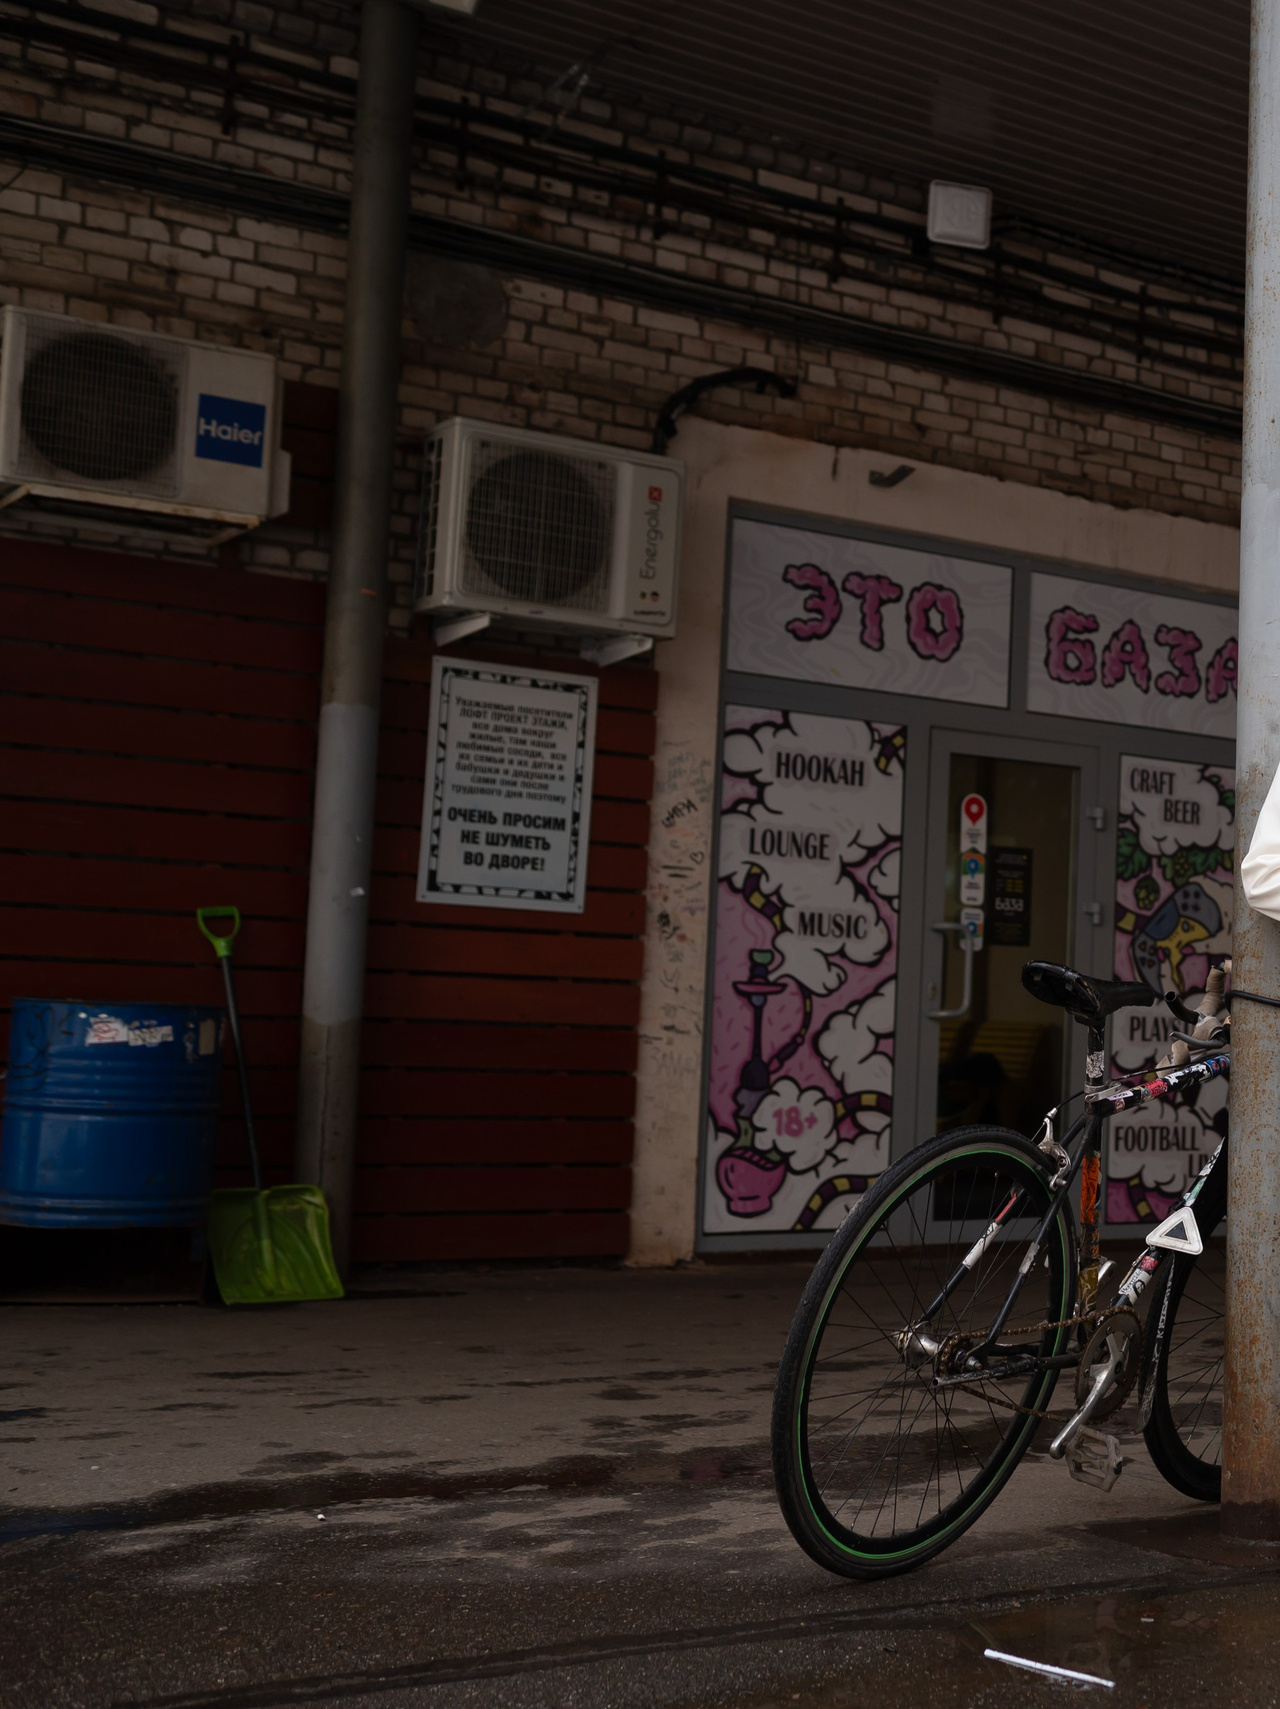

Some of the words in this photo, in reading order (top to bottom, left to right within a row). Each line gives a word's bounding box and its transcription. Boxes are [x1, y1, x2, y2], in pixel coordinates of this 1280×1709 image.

[199, 416, 262, 446] Haier
[782, 563, 964, 663] ЭТО
[776, 751, 864, 787] HOOKAH
[1130, 766, 1176, 796] CRAFT
[448, 806, 498, 825] ОЧЕНЬ
[503, 812, 567, 832] ПРОСИМ
[1164, 799, 1201, 826] BEER
[461, 830, 481, 845] НЕ
[486, 832, 551, 851] ШУМЕТЬ
[749, 827, 830, 861] LOUNGE
[463, 851, 484, 867] ВО
[488, 854, 545, 871] ДВОРЕ!
[798, 911, 868, 940] MUSIC
[772, 1106, 818, 1137] 18+
[1114, 1125, 1200, 1152] FOOTBALL
